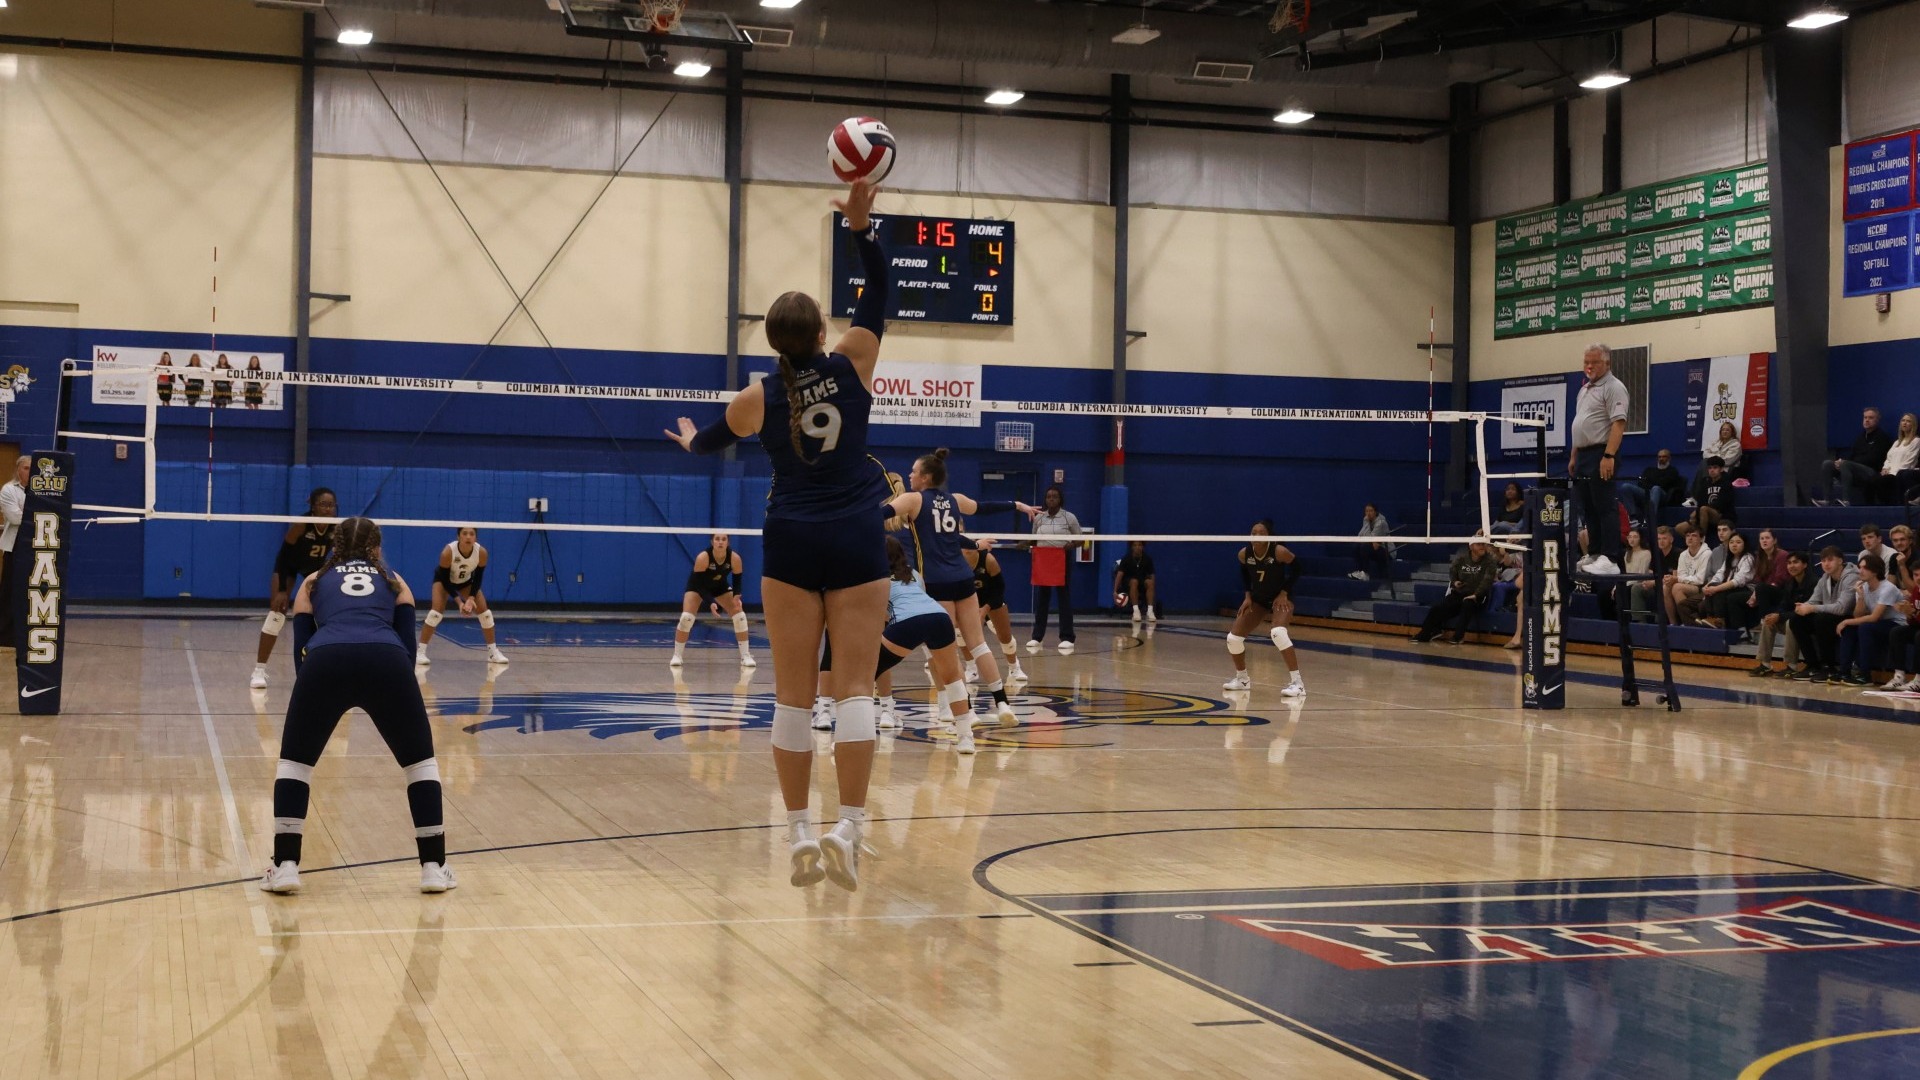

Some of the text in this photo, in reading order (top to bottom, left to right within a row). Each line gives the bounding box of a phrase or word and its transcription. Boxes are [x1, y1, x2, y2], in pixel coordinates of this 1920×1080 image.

[1849, 163, 1876, 176] REGIONAL
[1877, 156, 1909, 171] CHAMPIONS
[1736, 176, 1768, 197] CHAMP
[1849, 176, 1908, 194] WOMEN'S CROSS COUNTRY
[1655, 188, 1704, 213] CHAMPIONS
[1583, 204, 1626, 227] CHAMPIONS
[1672, 206, 1687, 218] 2022
[918, 221, 955, 247] 1:15
[968, 224, 1005, 236] HOME
[1515, 219, 1557, 240] CHAMPIONS
[1597, 222, 1611, 233] 2022
[1735, 224, 1771, 245] CHAMPI
[1529, 236, 1542, 246] 2021
[1654, 235, 1704, 259] CHAMPIONS
[1752, 239, 1769, 251] 2024
[1848, 242, 1873, 254] REGIONAL
[1875, 236, 1907, 250] CHAMPIONS
[989, 242, 1002, 265] 4
[1581, 249, 1626, 271] CHAMPIONS
[1670, 253, 1686, 265] 2023
[892, 256, 946, 273] PERIOD 1
[1515, 260, 1557, 281] CHAMPIONS
[1596, 266, 1611, 276] 2023
[1864, 258, 1890, 270] SOFTBALL
[849, 278, 997, 292] FOU PLAYER-FOUL FOULS
[1522, 276, 1550, 288] 2022-2023
[1734, 271, 1773, 292] CHAMPIO
[1653, 282, 1703, 304] CHAMPIONS
[1752, 288, 1768, 299] 2025
[982, 293, 993, 312] 0
[1581, 293, 1626, 314] CHAMPIONS
[1670, 299, 1686, 310] 2025
[1515, 302, 1556, 322] CHAMPIONS
[1596, 310, 1610, 320] 2024
[1528, 319, 1542, 328] 2024
[97, 349, 118, 361] kw
[226, 369, 454, 389] COLUMBIA INTERNATIONAL UNIVERSITY
[873, 378, 975, 398] OWL SHOT
[506, 383, 721, 400] COLUMBIA INTERNATIONAL UNIVERSITY
[797, 377, 839, 407] AMS
[871, 398, 972, 408] TIONAL UNIVERSITY
[1017, 402, 1208, 415] COLUMBIA INTERNATIONAL UNIVERSITY
[1713, 402, 1737, 421] CIU
[1251, 408, 1430, 419] COLUMBIA INTERNATIONAL UNIVERSITY
[801, 402, 842, 453] 9
[31, 476, 67, 492] CIU
[932, 509, 956, 533] 16
[1540, 509, 1562, 523] CIU
[310, 545, 326, 557] 21
[335, 566, 378, 574] RAMS
[1256, 570, 1265, 582] 7
[28, 512, 60, 664] RAMS
[340, 573, 375, 596] 8
[1542, 540, 1561, 666] RAMS
